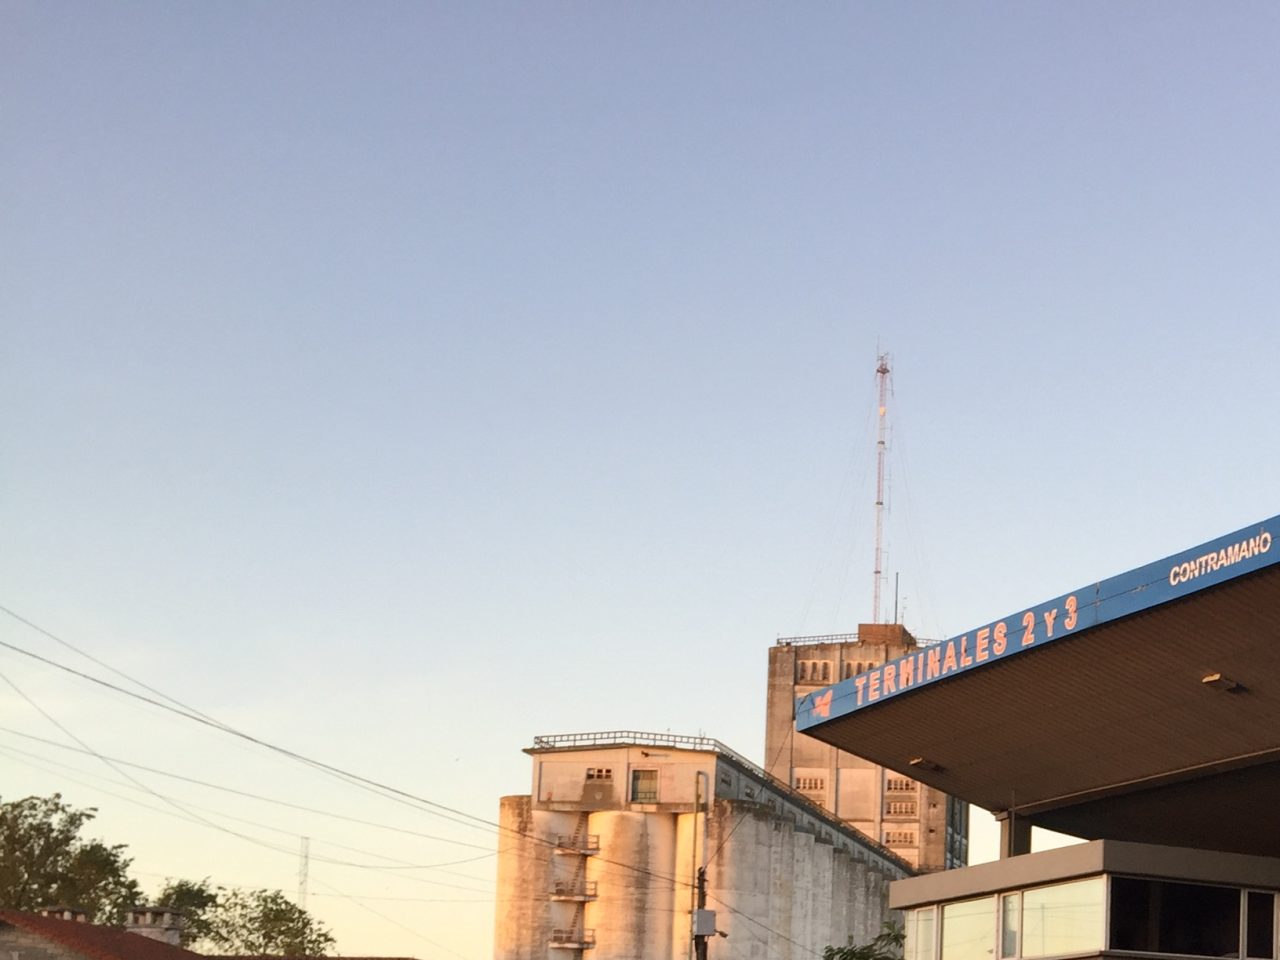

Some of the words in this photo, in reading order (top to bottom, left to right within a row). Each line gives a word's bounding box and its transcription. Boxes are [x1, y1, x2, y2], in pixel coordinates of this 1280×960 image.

[1169, 532, 1272, 586] CONTRAMANO
[854, 622, 1008, 706] TERMINALES
[1021, 611, 1036, 646] 2
[1064, 595, 1079, 631] 3
